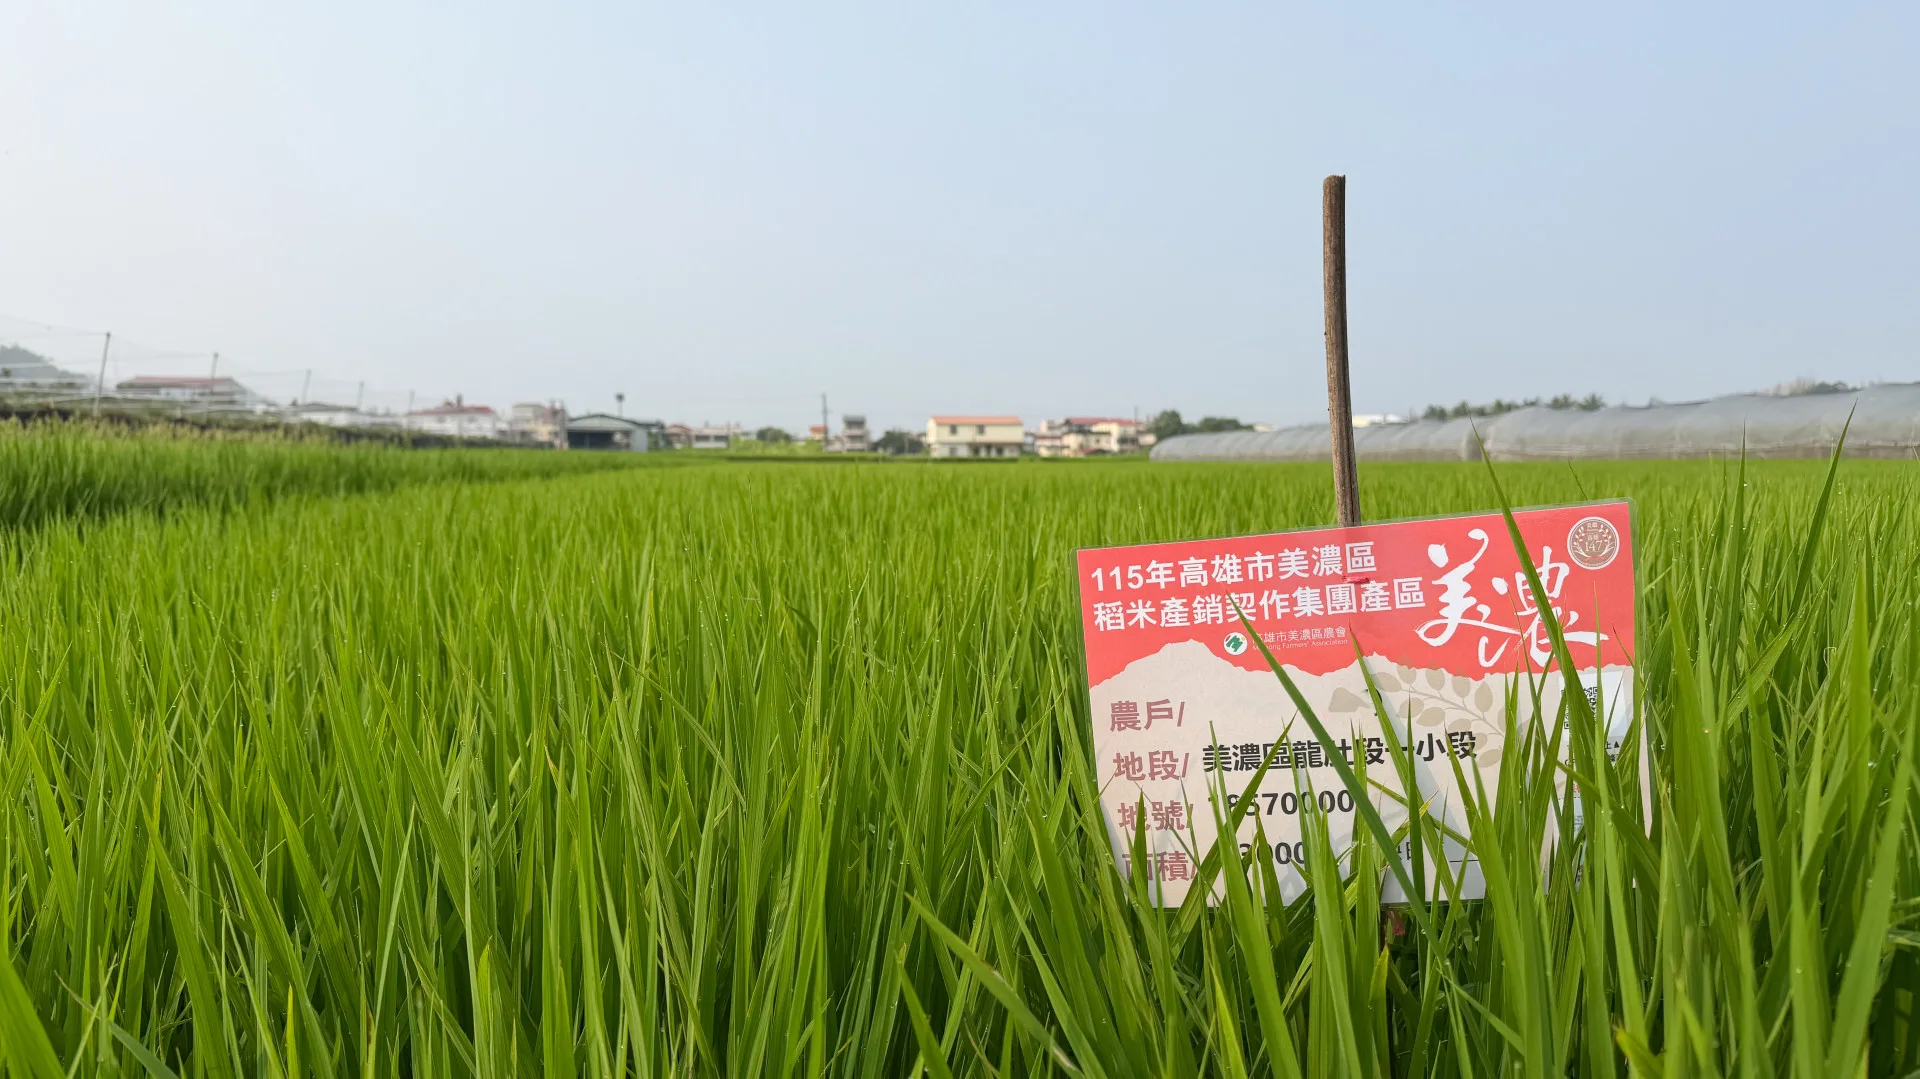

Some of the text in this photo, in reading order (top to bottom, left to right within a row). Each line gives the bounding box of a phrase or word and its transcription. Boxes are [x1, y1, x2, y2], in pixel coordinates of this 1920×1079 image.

[1091, 541, 1377, 592] 115年高雄市美濃區
[1093, 576, 1426, 631] 稻米產銷契作集團產區
[1413, 528, 1610, 667] 美濃
[1252, 625, 1346, 645] 雄市美濃區農會
[1311, 638, 1348, 647] Association
[1109, 699, 1185, 732] 農戶/
[1112, 750, 1190, 781] 地段/
